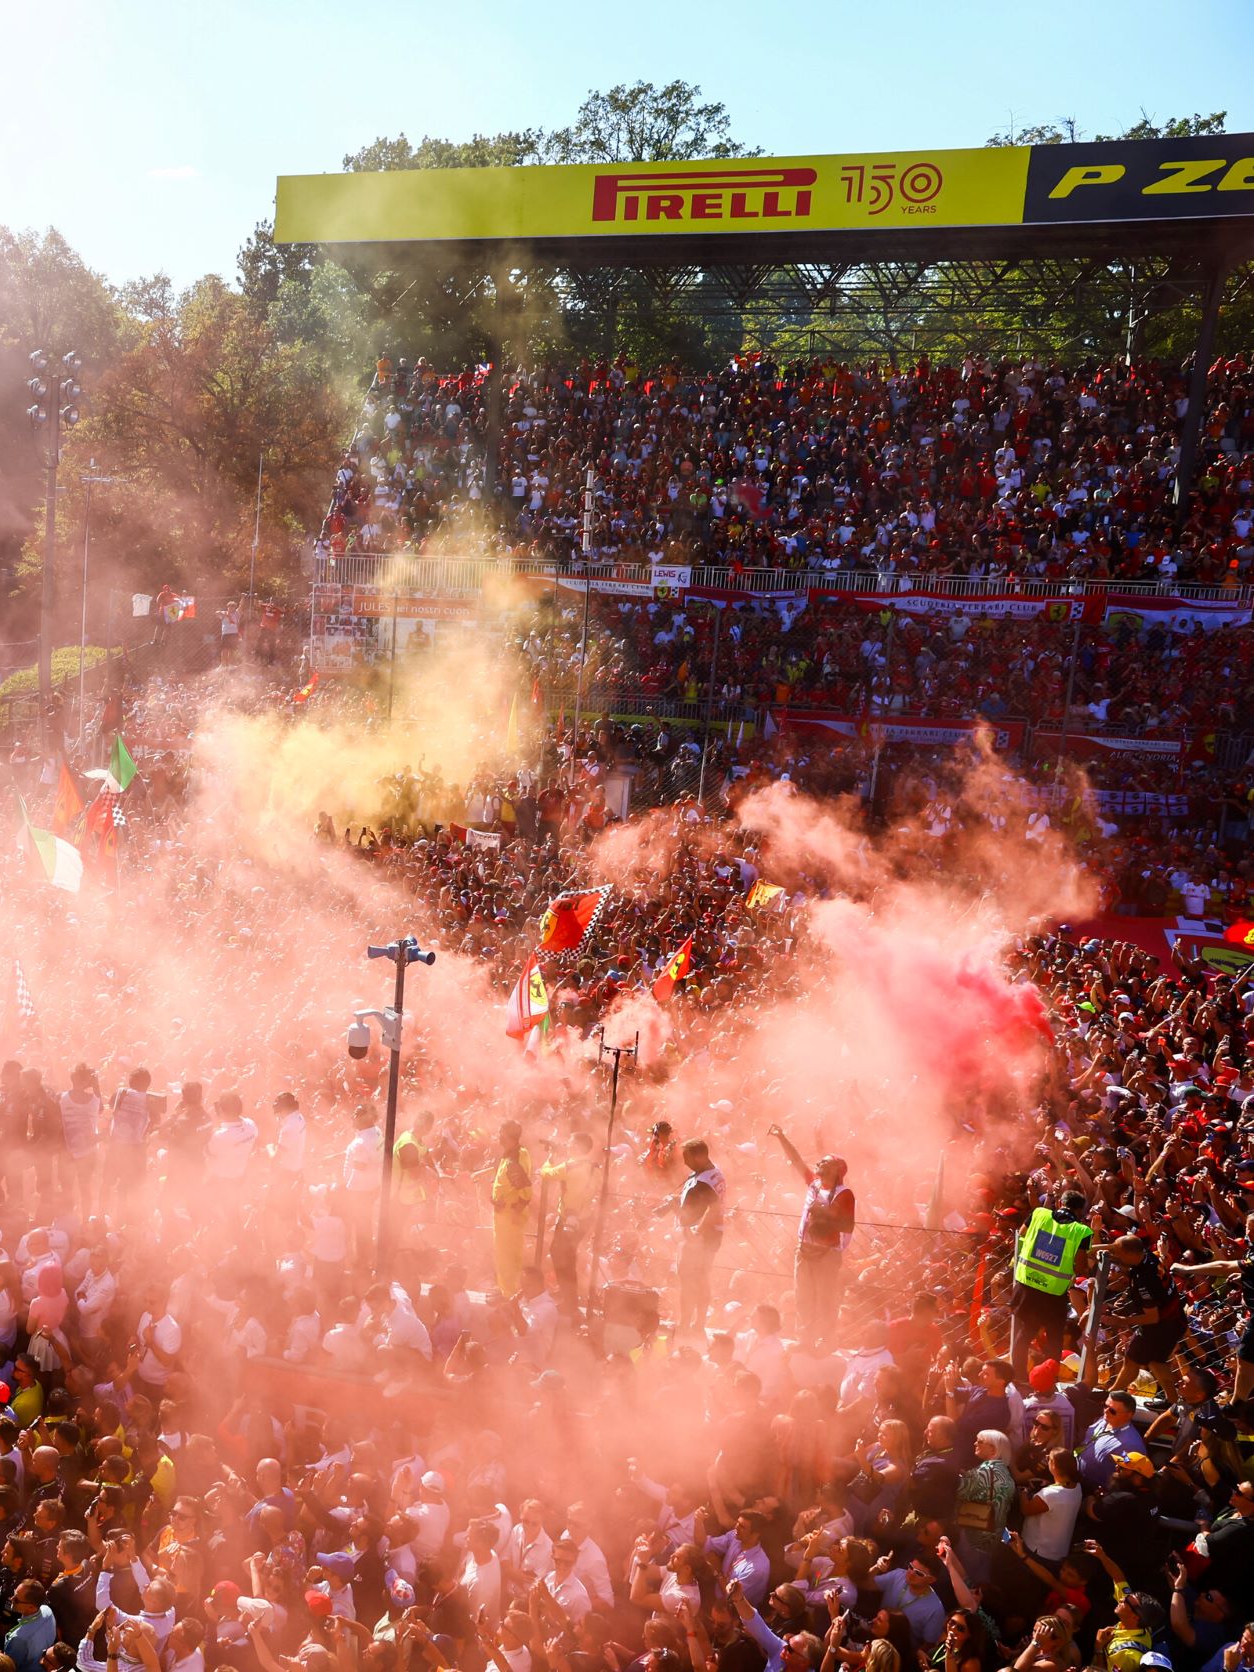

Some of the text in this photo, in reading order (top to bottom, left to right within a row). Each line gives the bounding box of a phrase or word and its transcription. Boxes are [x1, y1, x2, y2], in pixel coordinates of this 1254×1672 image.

[1048, 164, 1126, 199] P
[592, 162, 943, 222] PIRELLI 150
[901, 205, 937, 214] YEARS
[654, 570, 677, 578] LEWIS
[358, 601, 391, 612] JULES
[1009, 604, 1037, 612] CLUB
